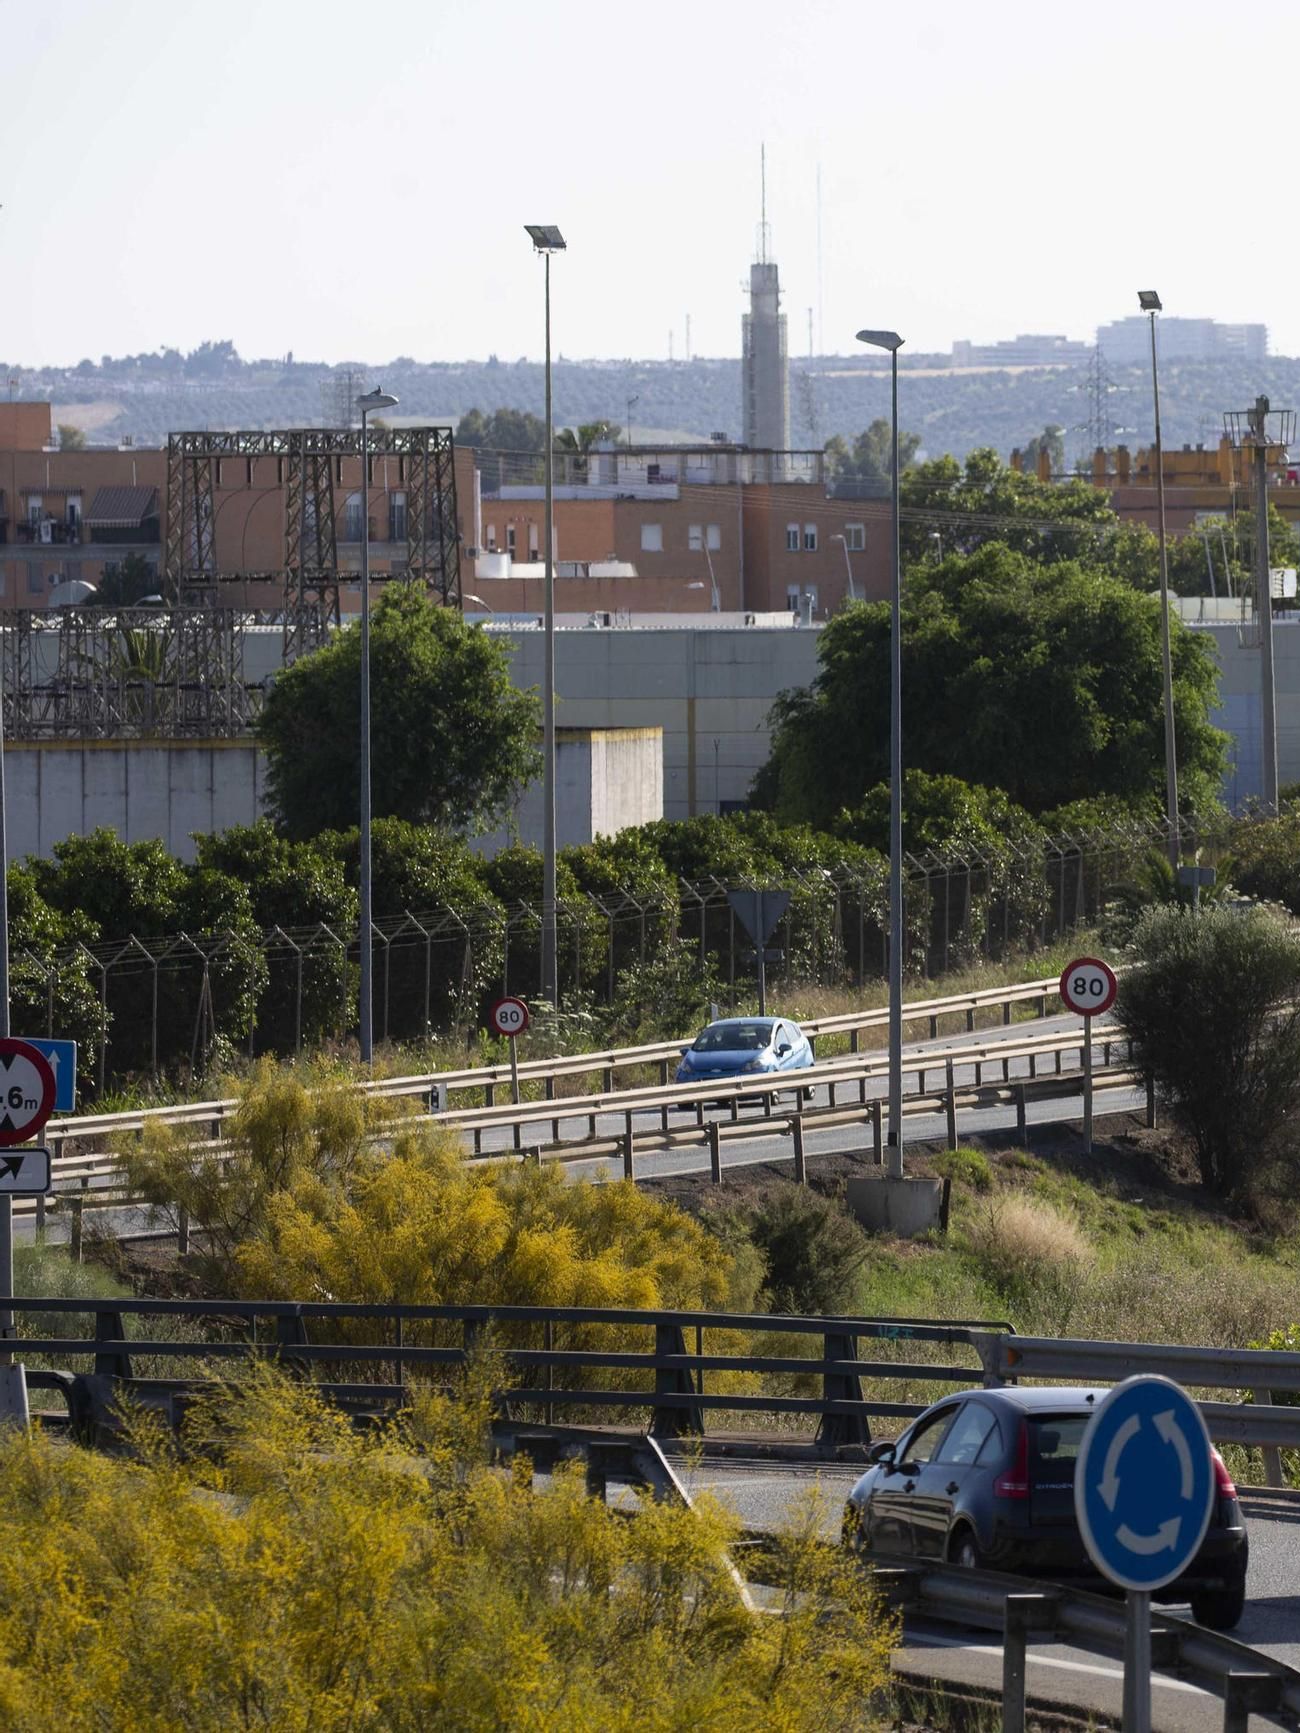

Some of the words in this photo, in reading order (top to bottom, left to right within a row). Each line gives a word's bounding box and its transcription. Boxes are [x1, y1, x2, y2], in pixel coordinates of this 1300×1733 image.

[1073, 977, 1104, 997] 80
[500, 1011, 519, 1024] 80
[0, 1086, 38, 1109] .6m
